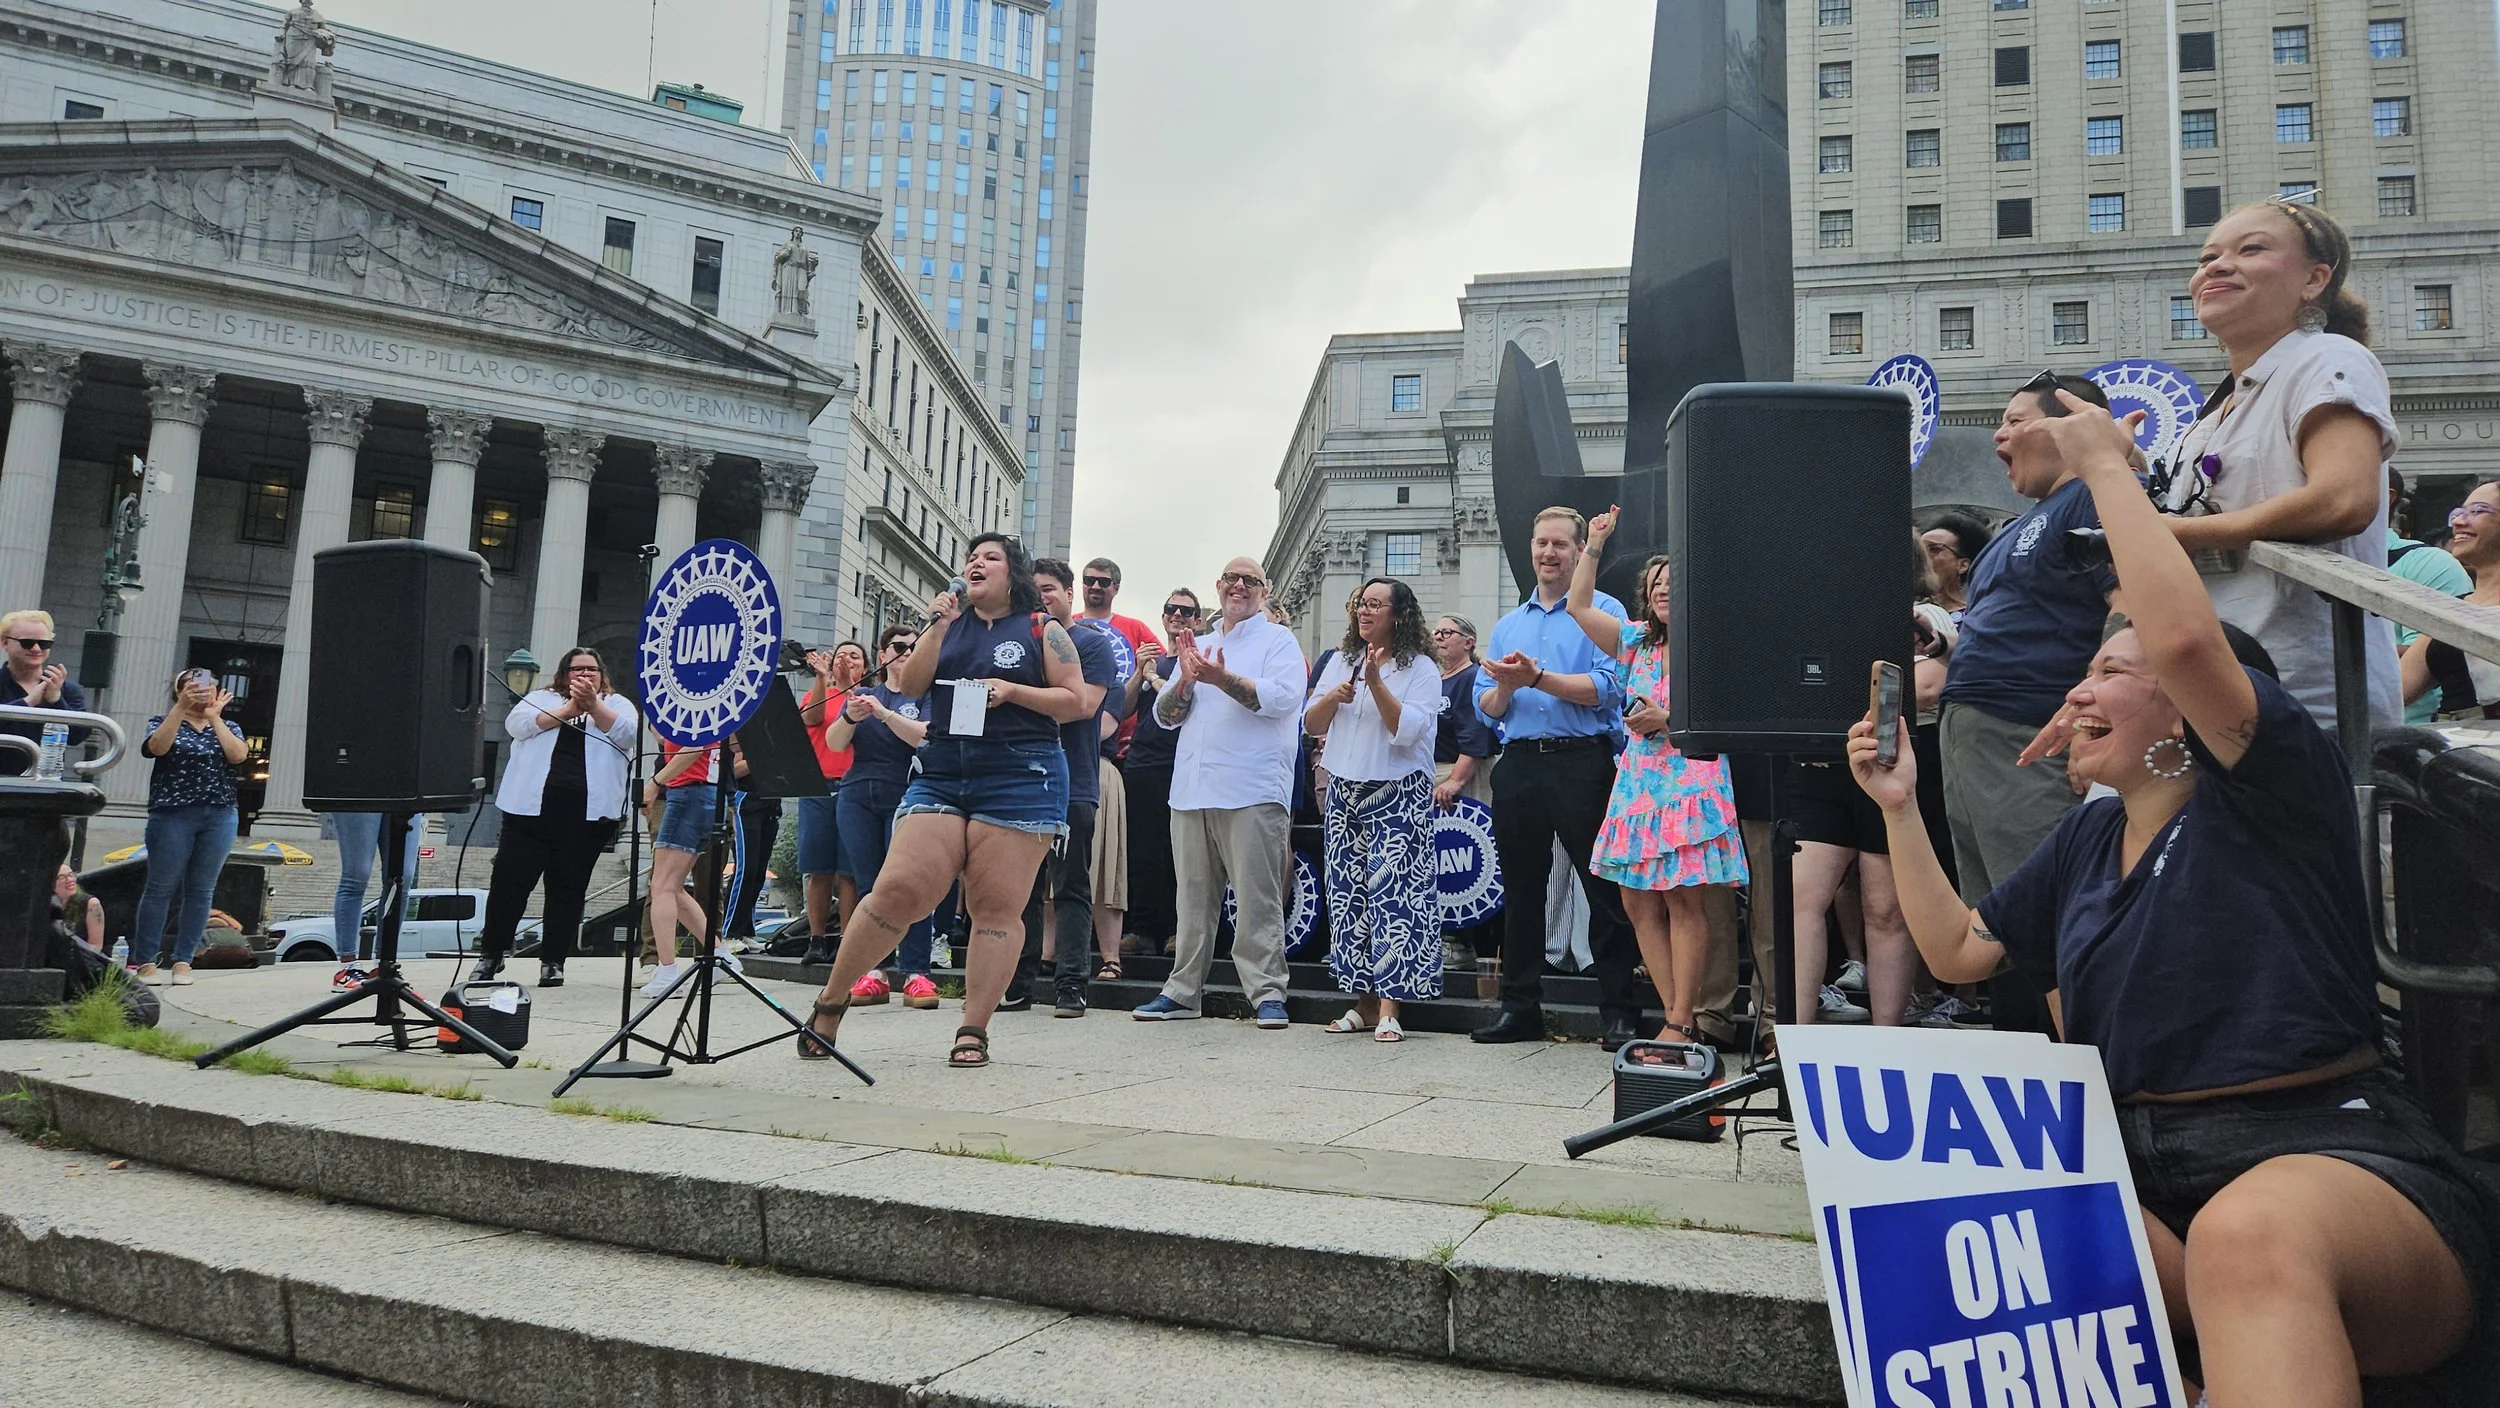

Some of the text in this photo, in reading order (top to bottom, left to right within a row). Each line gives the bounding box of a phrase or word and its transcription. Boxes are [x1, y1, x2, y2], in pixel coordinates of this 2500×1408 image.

[36, 284, 75, 307] OF
[81, 290, 200, 328] JUSTICE
[213, 313, 237, 335] IS
[248, 318, 295, 345] THE
[308, 329, 415, 365] FIRMEST
[424, 350, 504, 381] PILLAR
[511, 365, 543, 386] OF
[553, 372, 624, 400] GOOD
[634, 386, 789, 429] GOVERNMENT
[676, 622, 736, 665] UAW
[1835, 1065, 2085, 1173] UAW
[1945, 1209, 2052, 1320] ON
[1885, 1304, 2157, 1408] STRIKE
